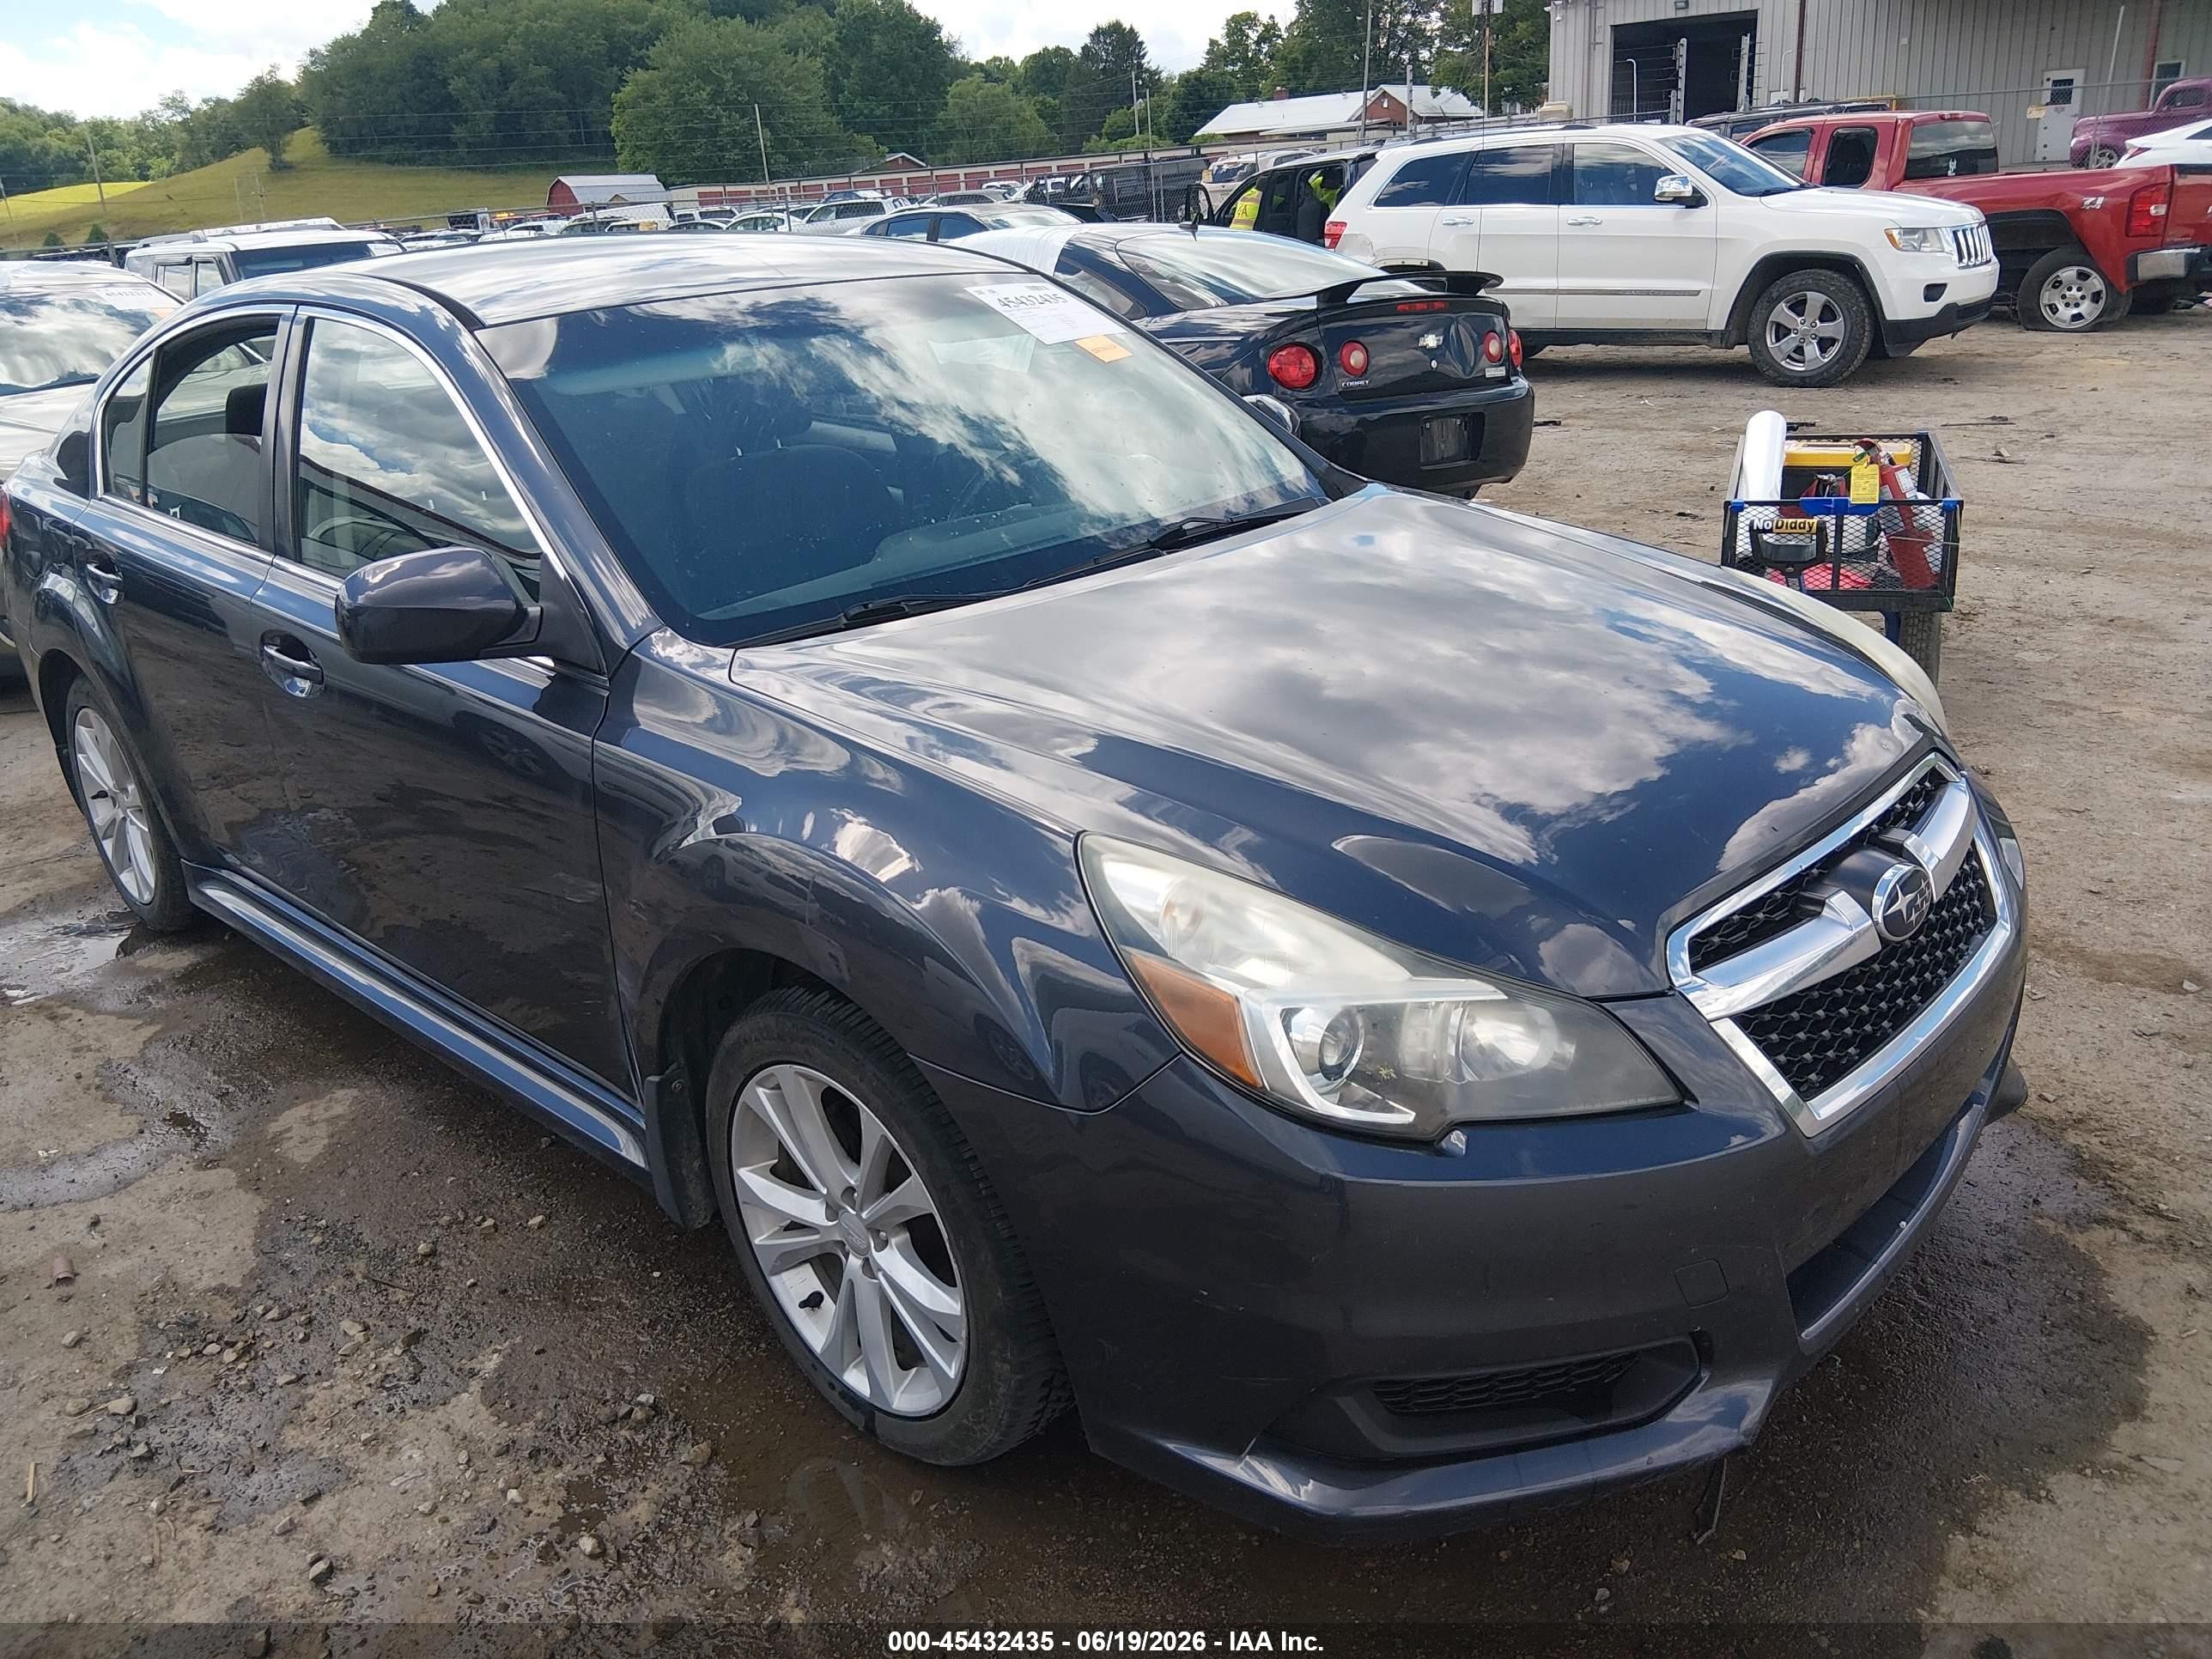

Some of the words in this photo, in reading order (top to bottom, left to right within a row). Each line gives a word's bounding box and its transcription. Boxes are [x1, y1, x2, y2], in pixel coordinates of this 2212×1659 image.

[997, 294, 1068, 308] 45432435
[1341, 380, 1369, 388] COBALT
[1753, 519, 1772, 531] No
[1775, 520, 1815, 532] Diddy
